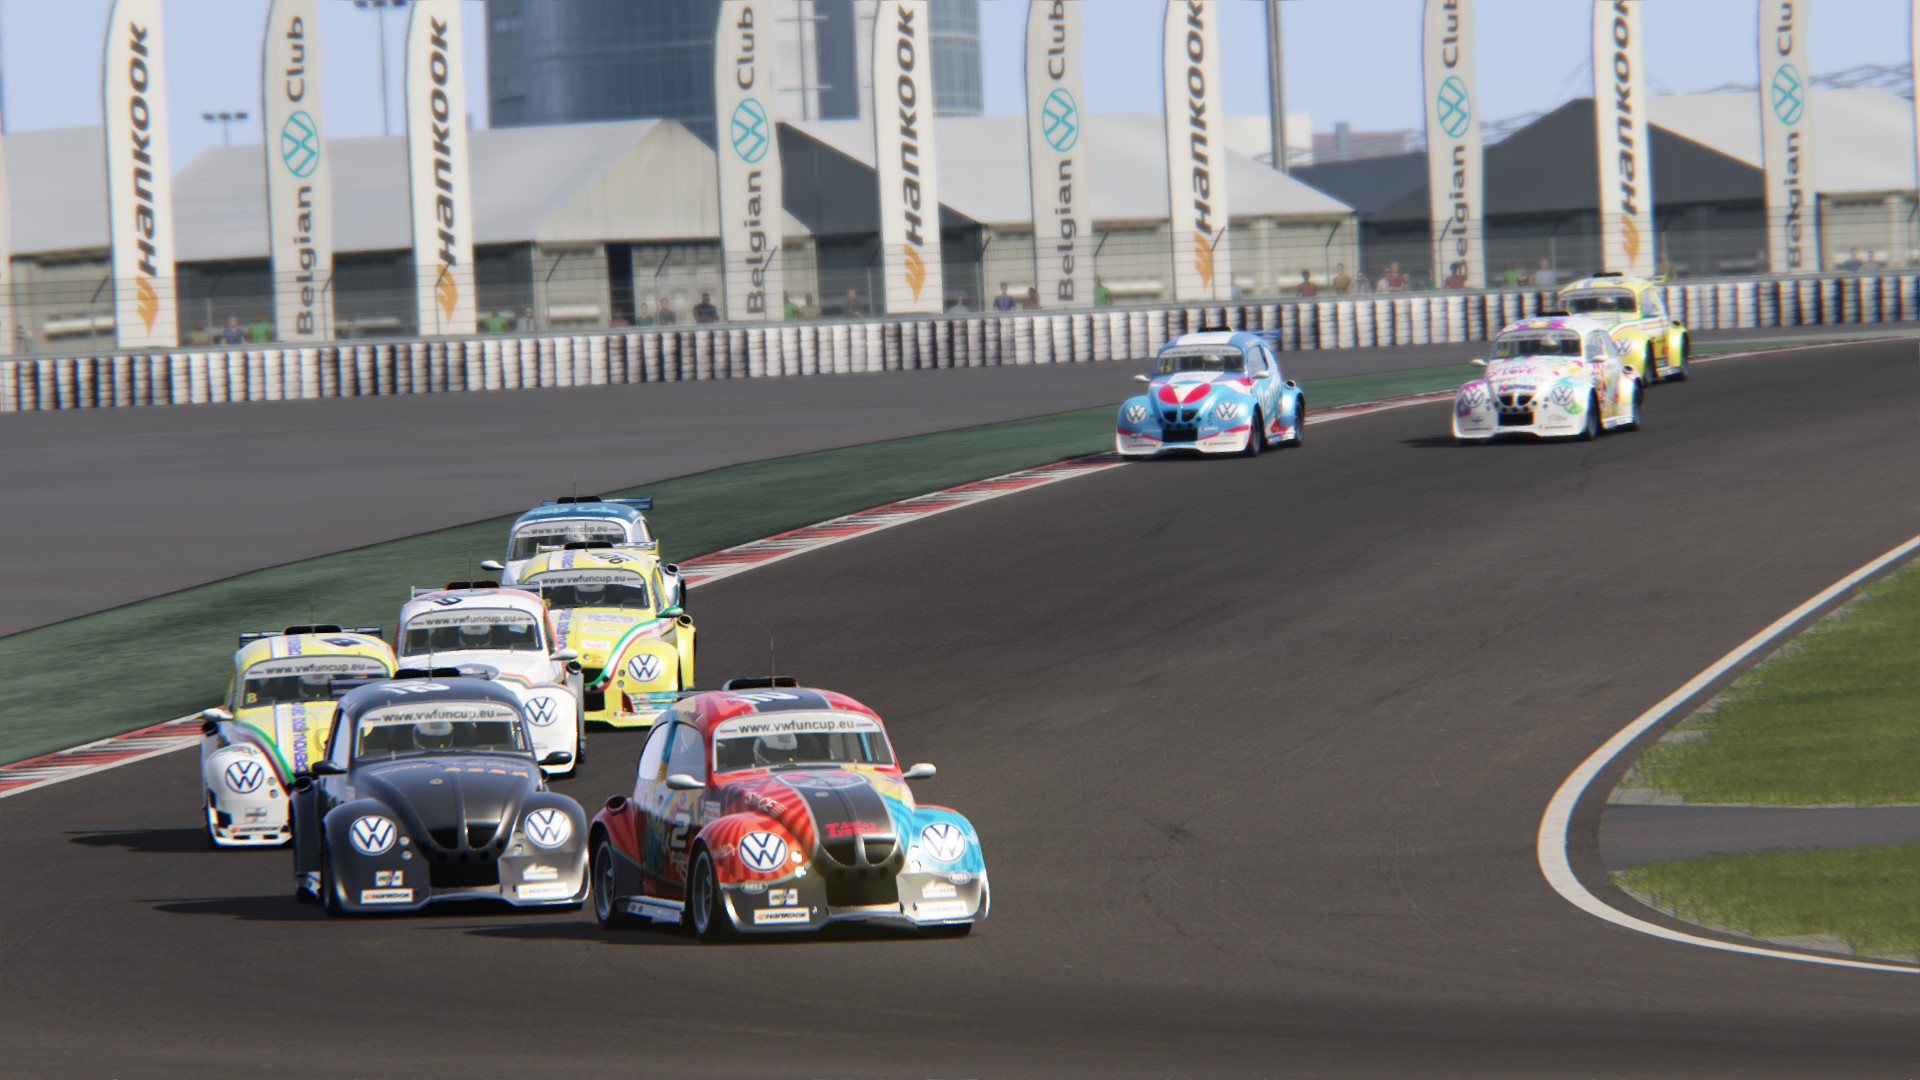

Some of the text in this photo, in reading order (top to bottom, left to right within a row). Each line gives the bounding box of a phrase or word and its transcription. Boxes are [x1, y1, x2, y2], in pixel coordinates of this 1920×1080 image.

[1047, 0, 1066, 81] Club
[1776, 2, 1794, 57] Clu
[285, 15, 306, 103] Club
[736, 6, 756, 91] Club
[743, 169, 767, 315] Belgian
[1054, 158, 1077, 302] Belgian
[293, 185, 317, 336] Belgian
[530, 526, 609, 535] www.vwfuncup.eu
[542, 574, 627, 584] www.vwfuncup.eu
[425, 614, 517, 626] www.vwfuncup.eu
[265, 662, 366, 675] www.vwfuncup.eu
[382, 708, 495, 724] www.vwfuncup.eu
[738, 719, 855, 734] www.vwfuncup.eu
[841, 820, 870, 829] Auto
